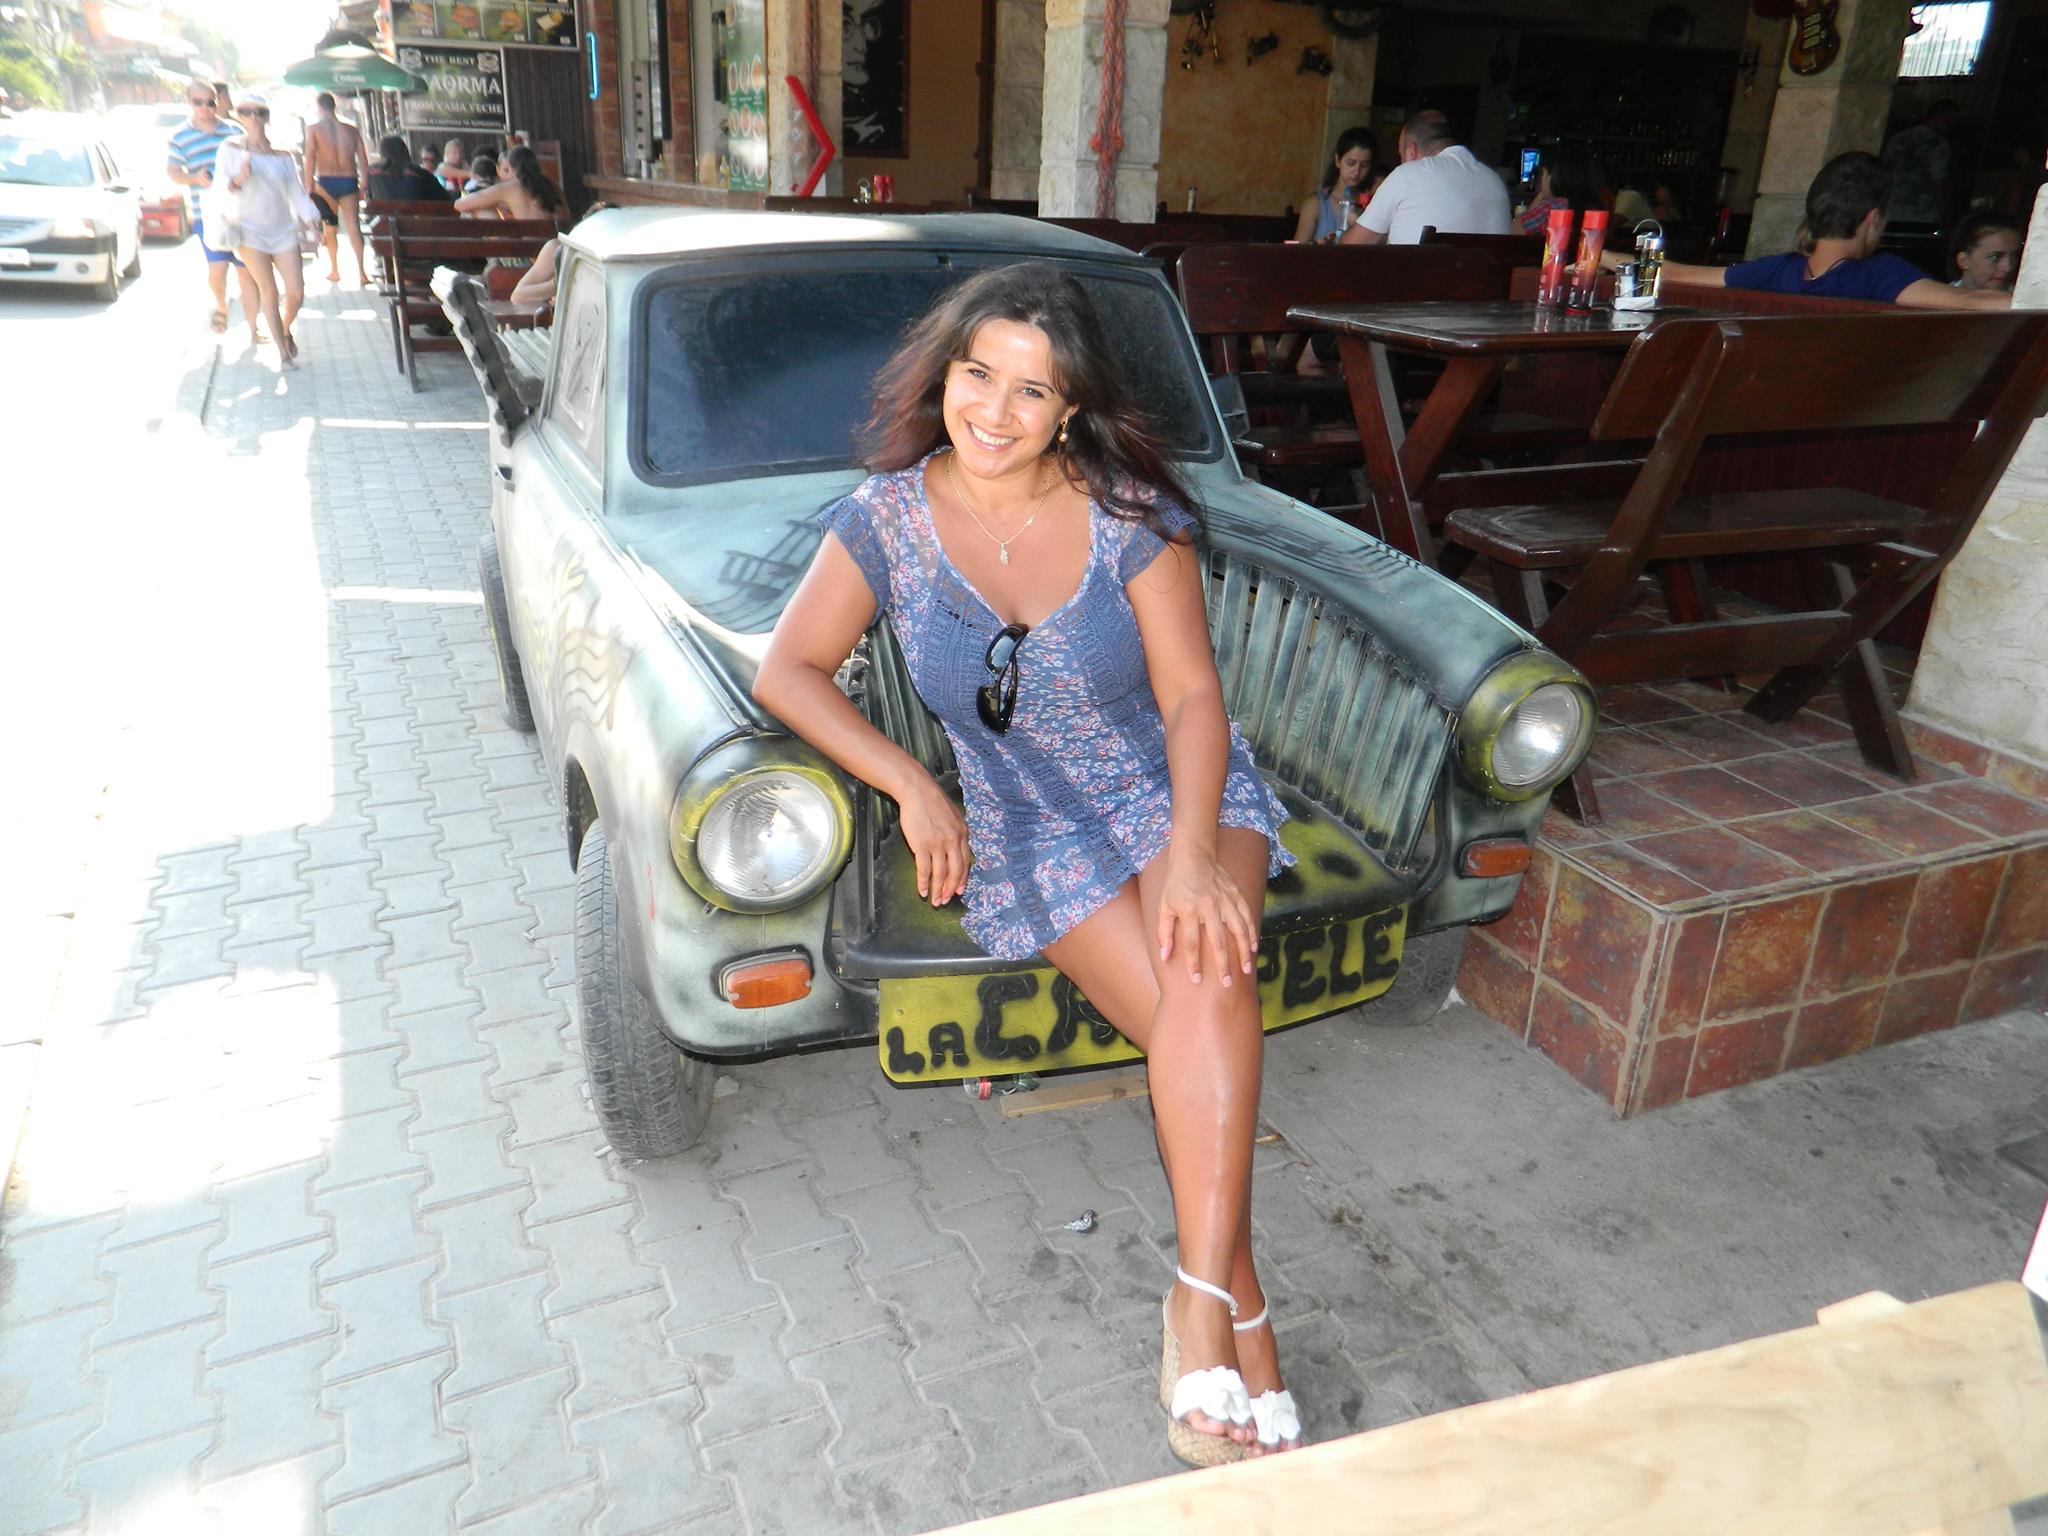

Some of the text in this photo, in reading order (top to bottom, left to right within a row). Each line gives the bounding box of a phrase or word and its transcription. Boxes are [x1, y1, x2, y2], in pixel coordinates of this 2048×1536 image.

[424, 55, 476, 65] THE BEST
[421, 73, 503, 97] AORMA
[404, 99, 504, 114] FROM VAMA VECHE
[886, 1021, 970, 1075] LA
